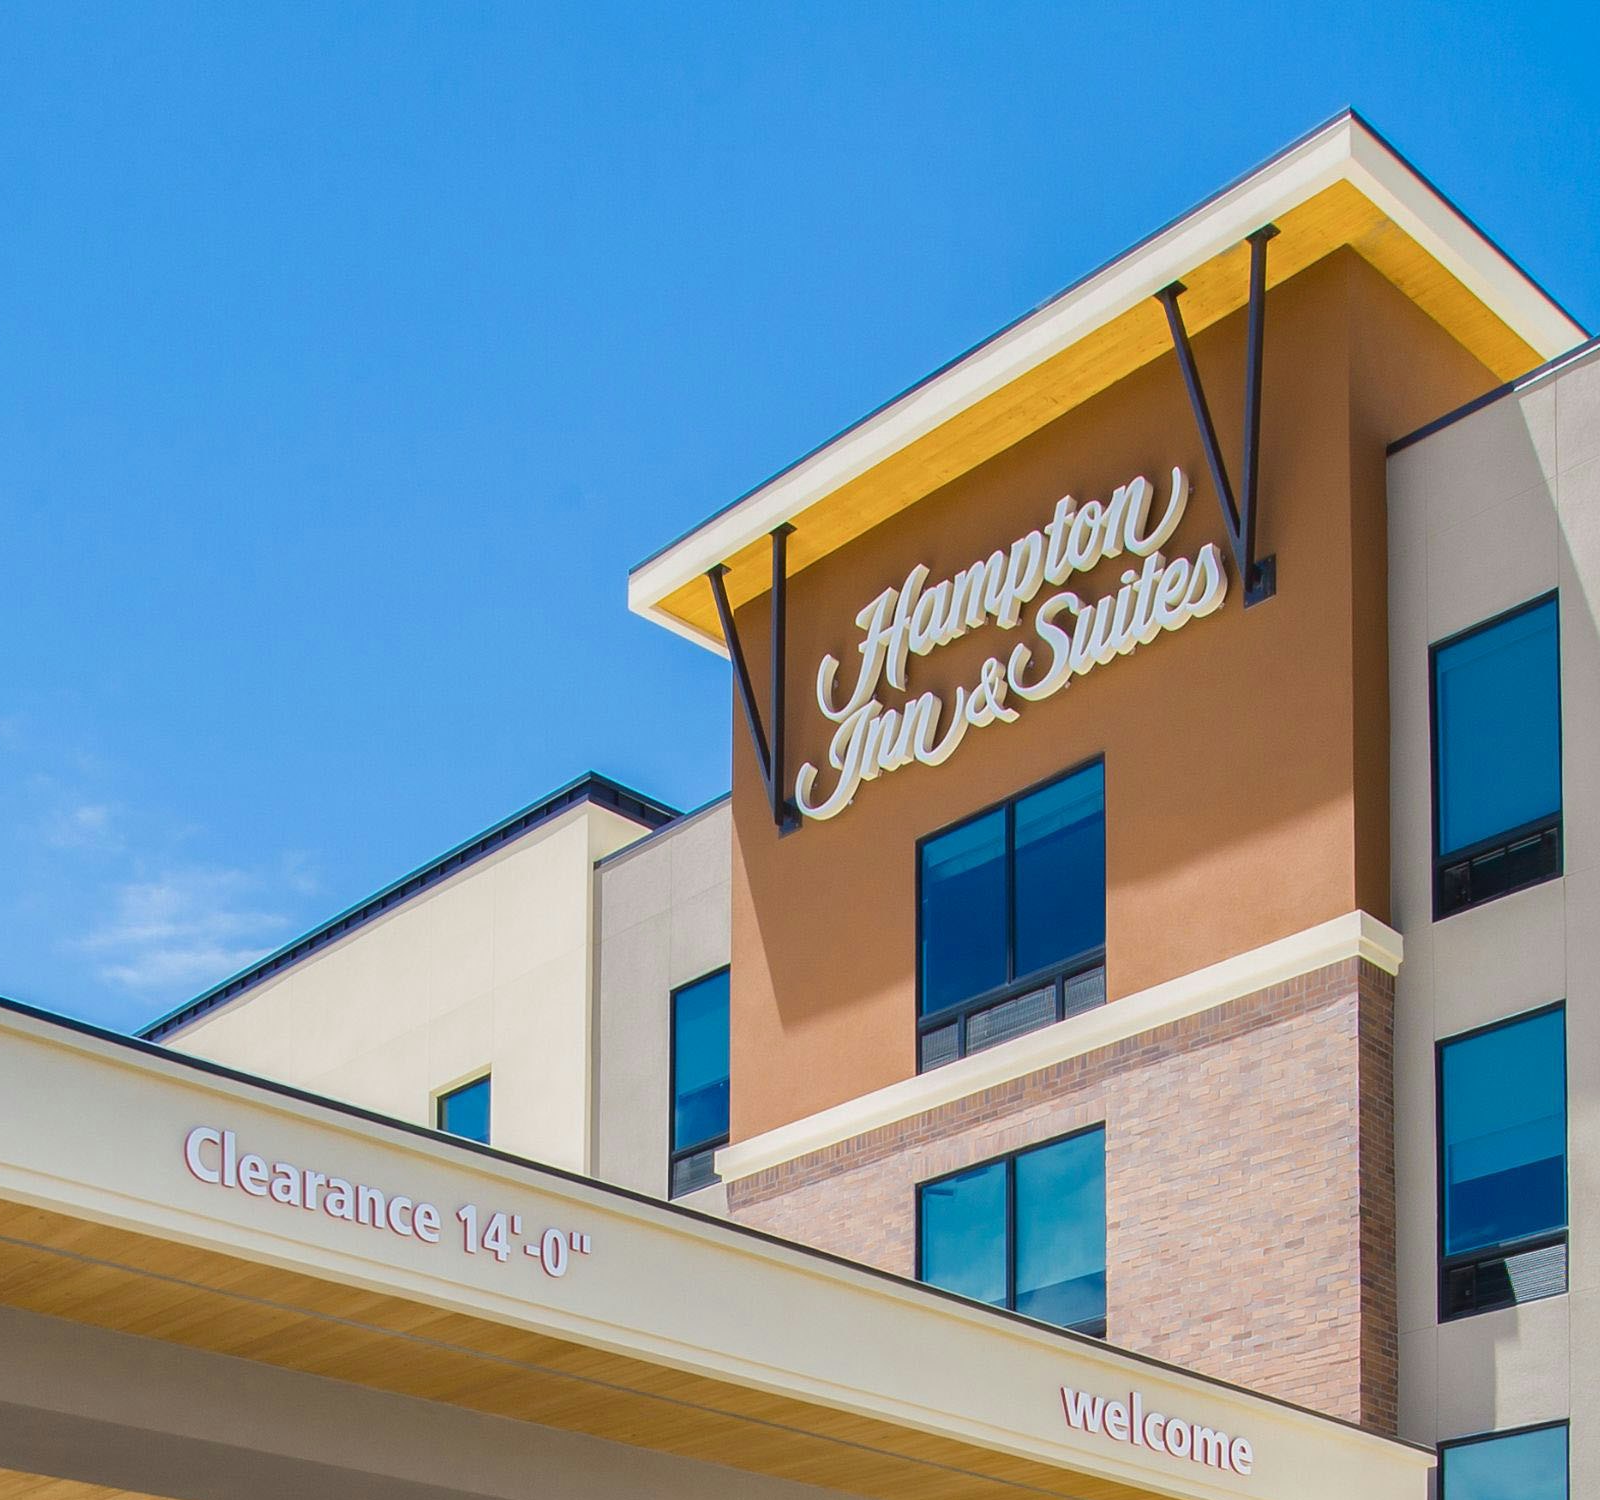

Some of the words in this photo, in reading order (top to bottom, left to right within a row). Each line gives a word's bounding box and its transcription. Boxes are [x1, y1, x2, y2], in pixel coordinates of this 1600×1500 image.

[795, 687, 968, 821] Inn
[966, 657, 1020, 727] &
[1009, 542, 1227, 700] Suites
[817, 466, 1188, 721] Hampton
[184, 1125, 441, 1243] Clearance
[456, 1203, 591, 1277] 14'-0"
[1060, 1386, 1253, 1476] welcome
